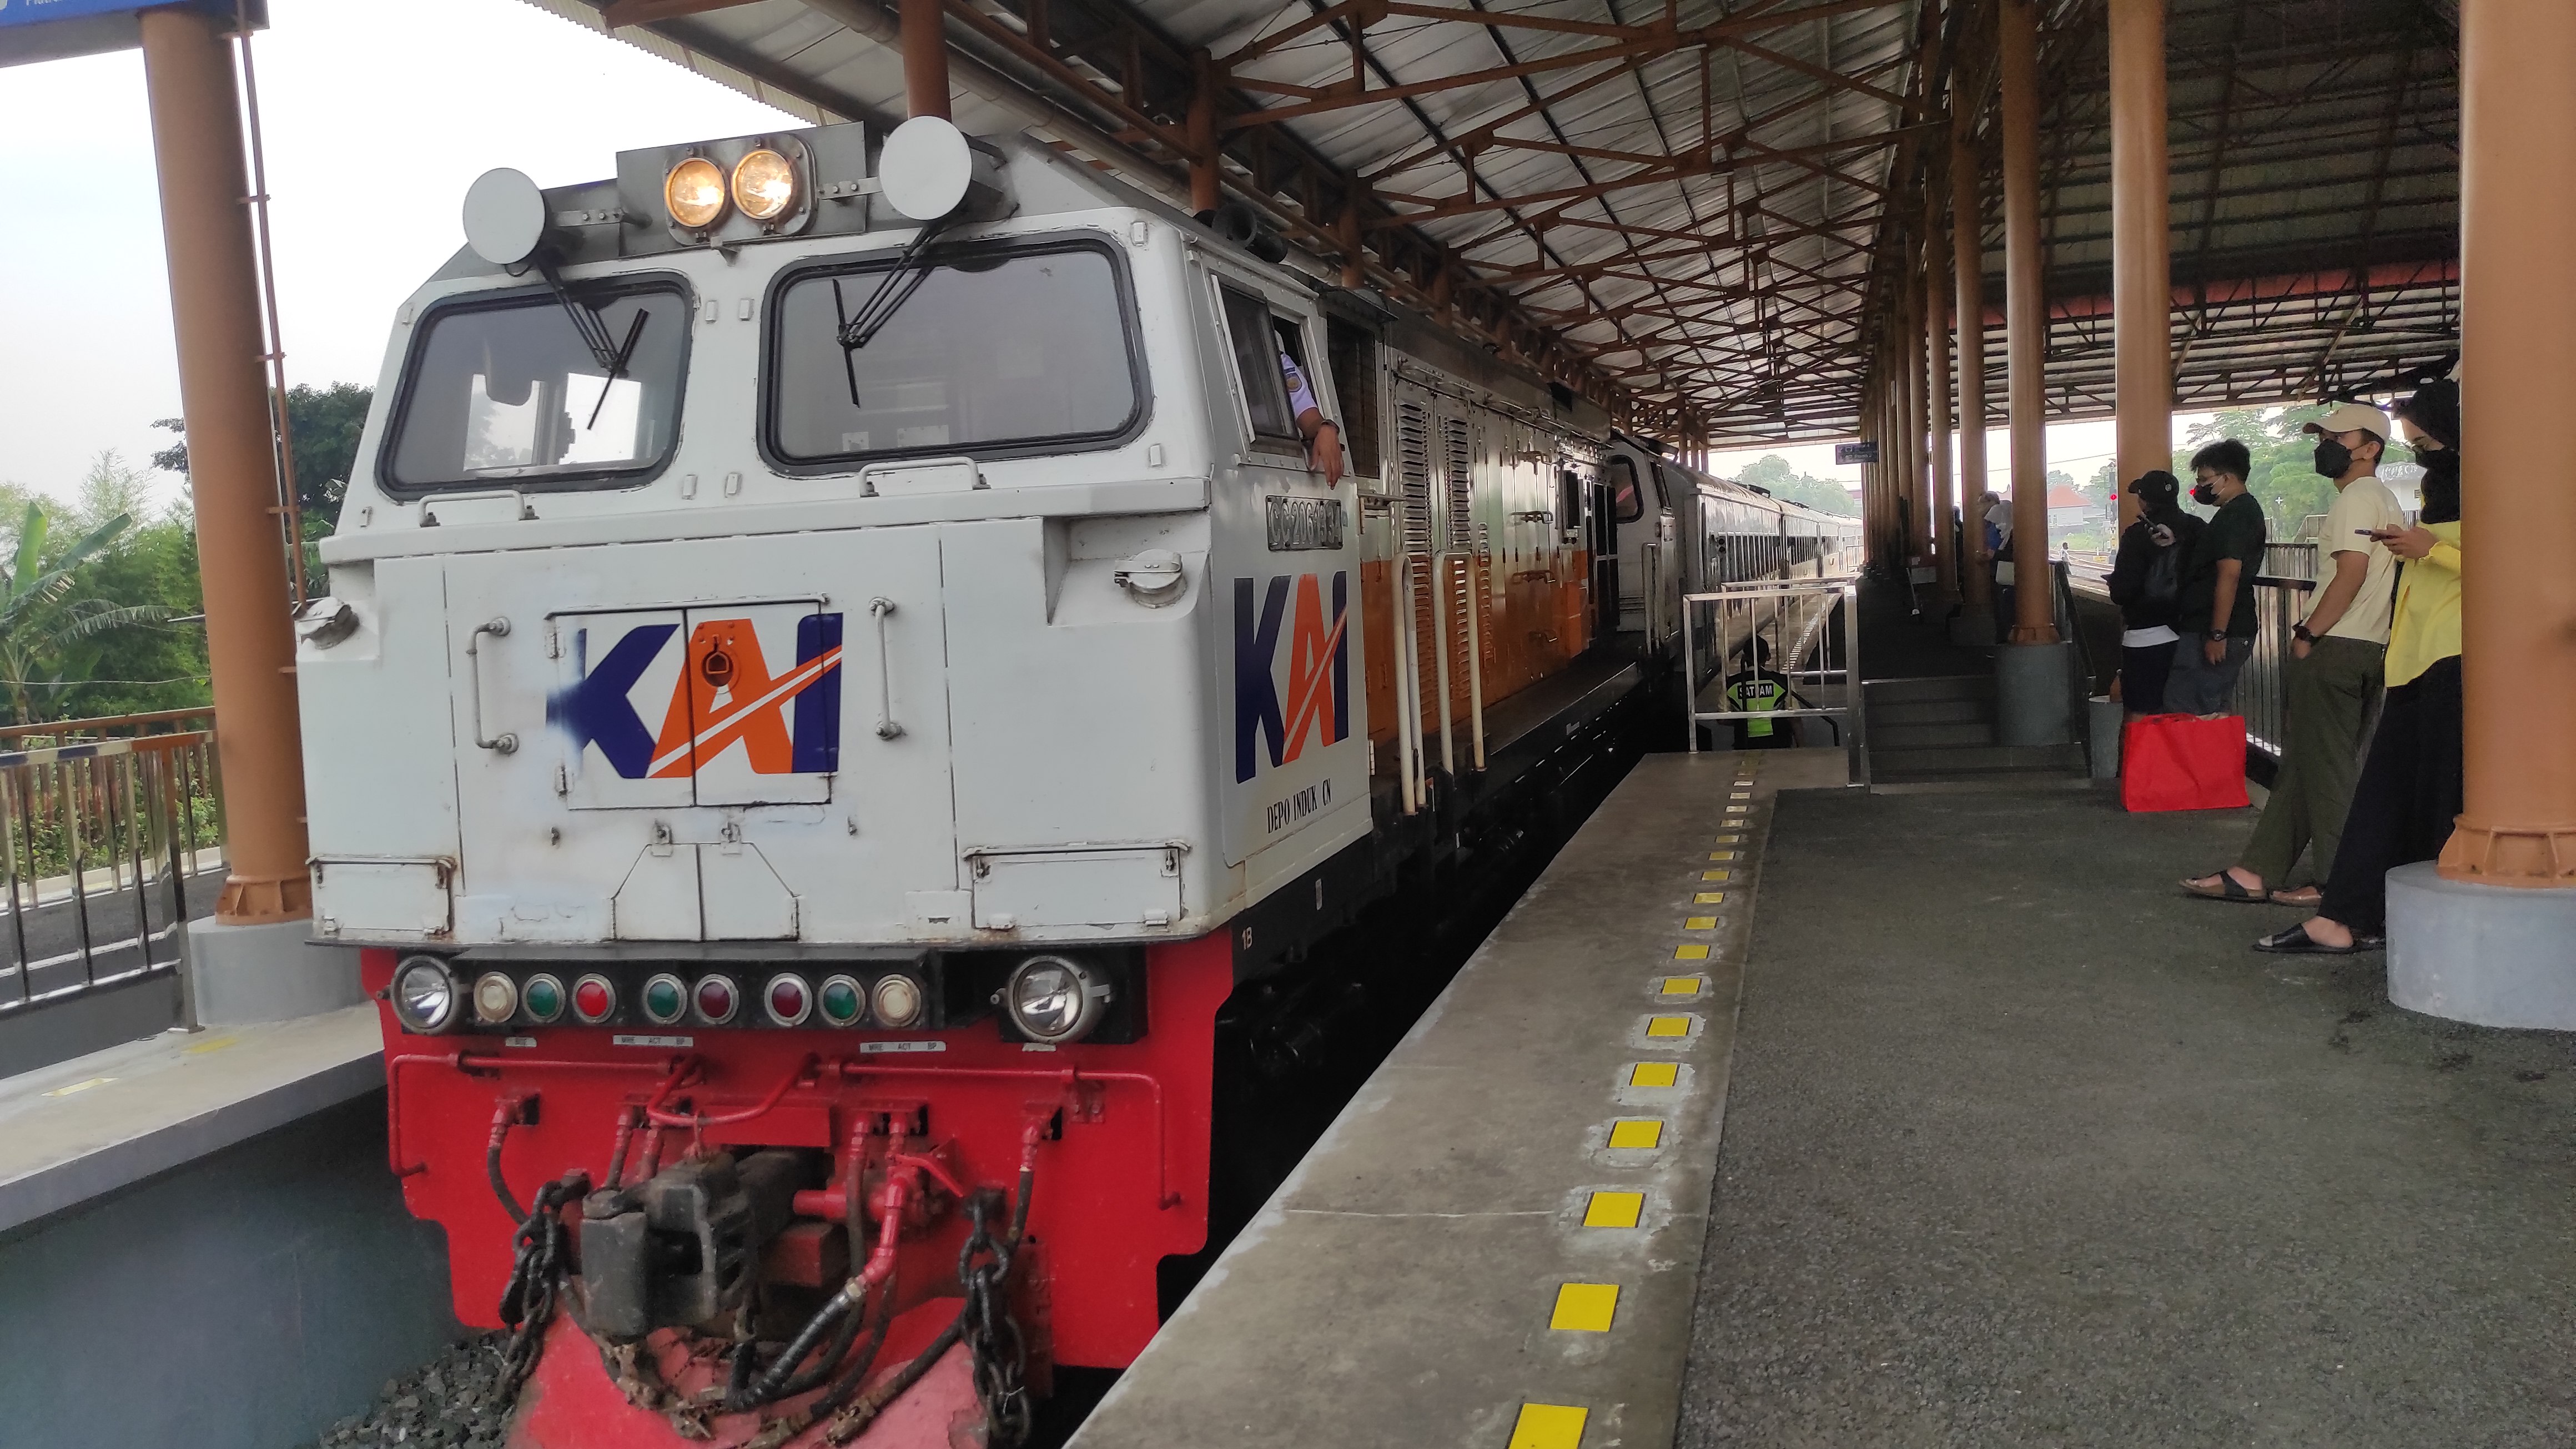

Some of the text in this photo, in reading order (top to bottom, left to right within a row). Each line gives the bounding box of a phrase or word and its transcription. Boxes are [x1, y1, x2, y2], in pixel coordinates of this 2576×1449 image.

[546, 612, 843, 779] KAI
[1234, 571, 1349, 784] KAI
[1739, 685, 1772, 697] SATAM
[1267, 778, 1331, 833] DEPO INDUK CN
[1242, 927, 1252, 950] 1B
